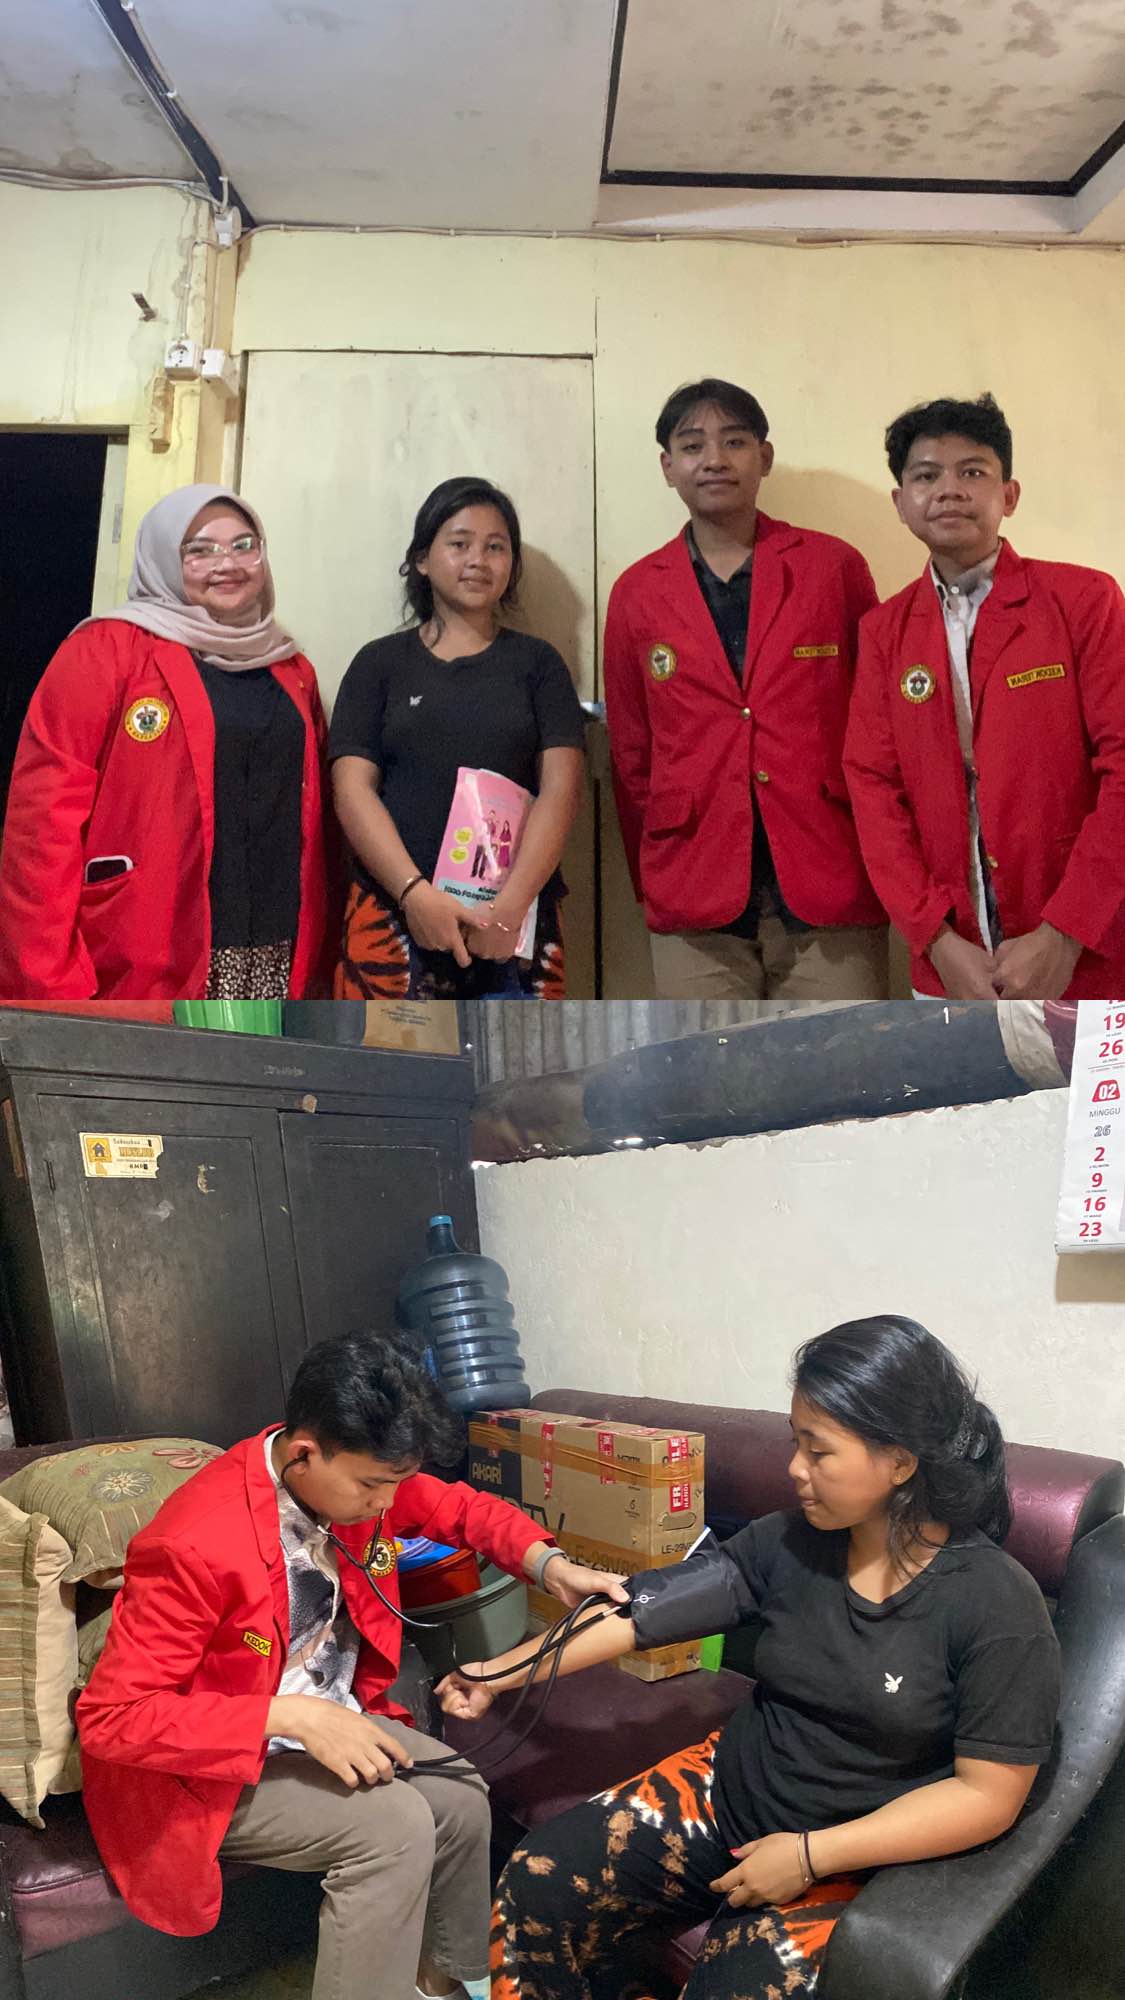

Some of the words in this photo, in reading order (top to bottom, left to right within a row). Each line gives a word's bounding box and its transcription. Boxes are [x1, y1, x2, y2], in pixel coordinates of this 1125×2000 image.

[1104, 1012, 1125, 1030] 19
[1099, 1039, 1123, 1058] 26
[1098, 1083, 1117, 1100] 02
[1093, 1146, 1105, 1162] 2
[1091, 1172, 1103, 1188] 9
[1083, 1196, 1106, 1212] 16
[1079, 1221, 1103, 1237] 23
